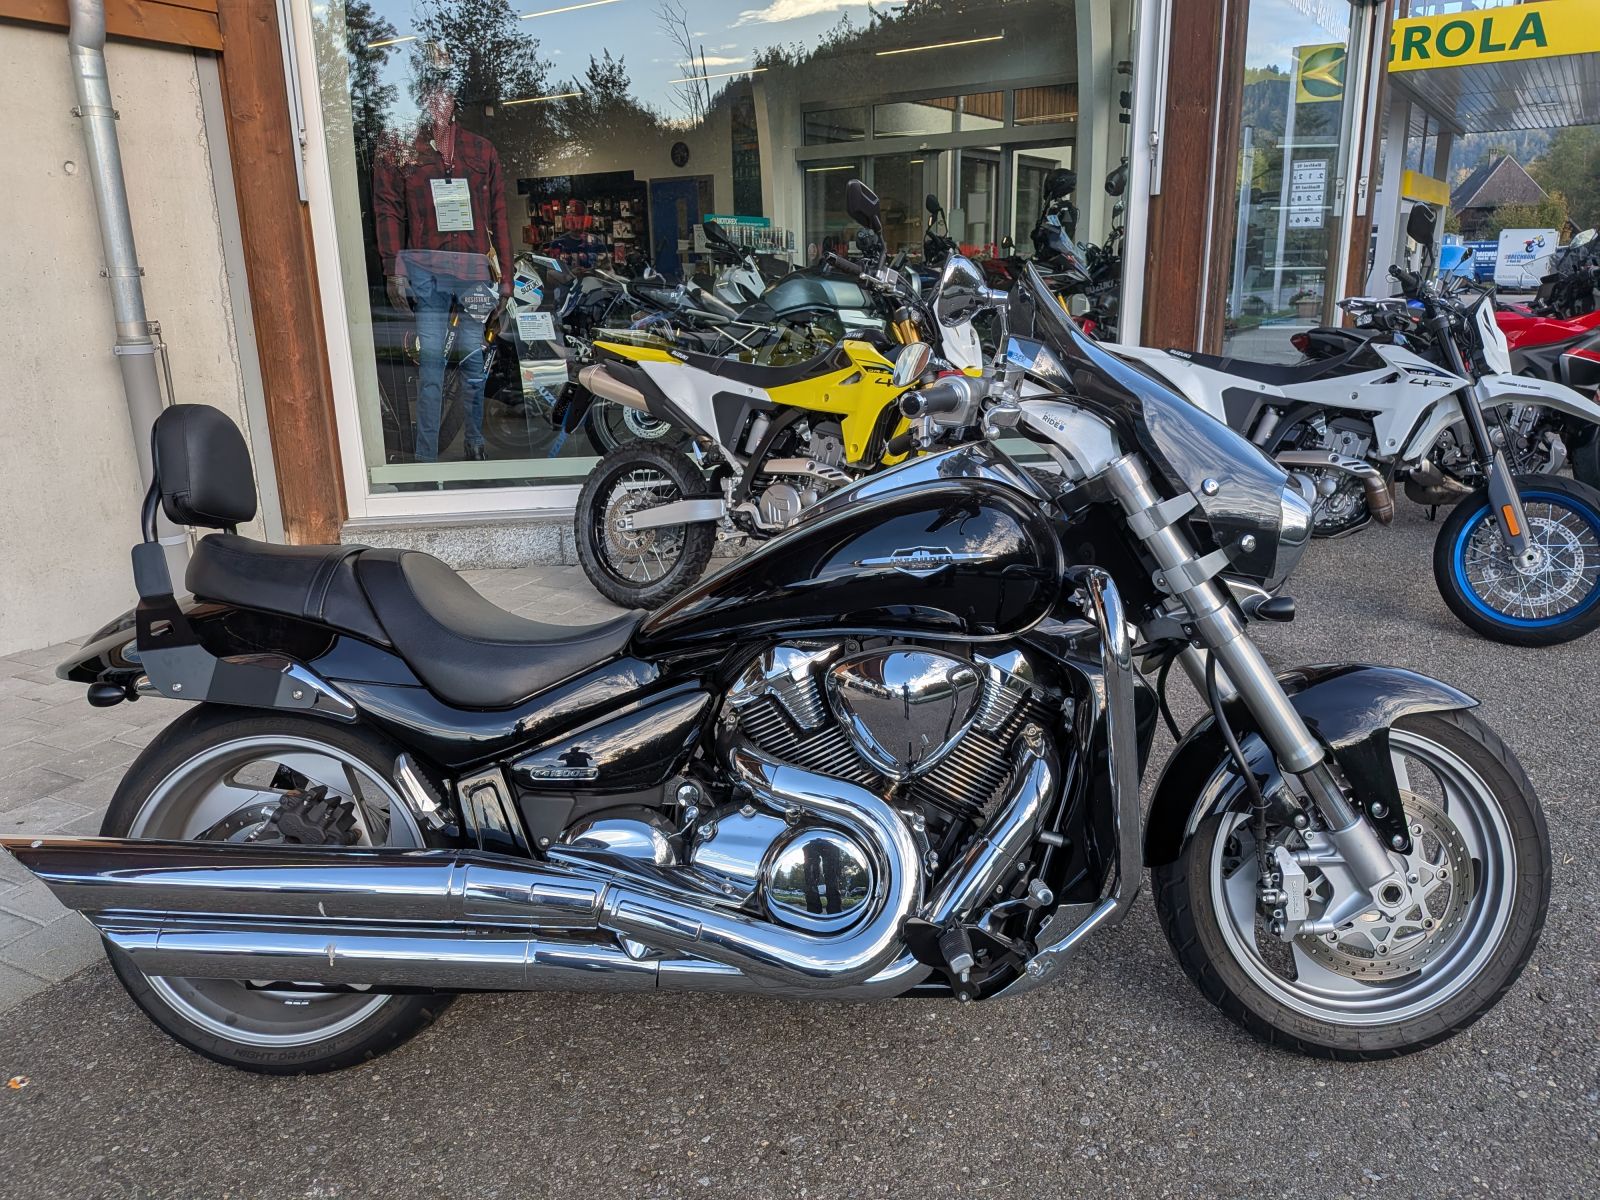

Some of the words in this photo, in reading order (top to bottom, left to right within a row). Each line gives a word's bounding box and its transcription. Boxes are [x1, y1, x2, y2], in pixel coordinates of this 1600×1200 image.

[1388, 12, 1548, 62] ROLA
[717, 217, 737, 225] MOTOREX
[520, 281, 540, 295] SUZUKI
[1085, 280, 1115, 294] SUZUKI
[671, 350, 689, 361] SUZUKI
[1170, 348, 1192, 359] SUZUKI
[1042, 414, 1060, 429] RIDE
[890, 554, 953, 566] INTRUDER
